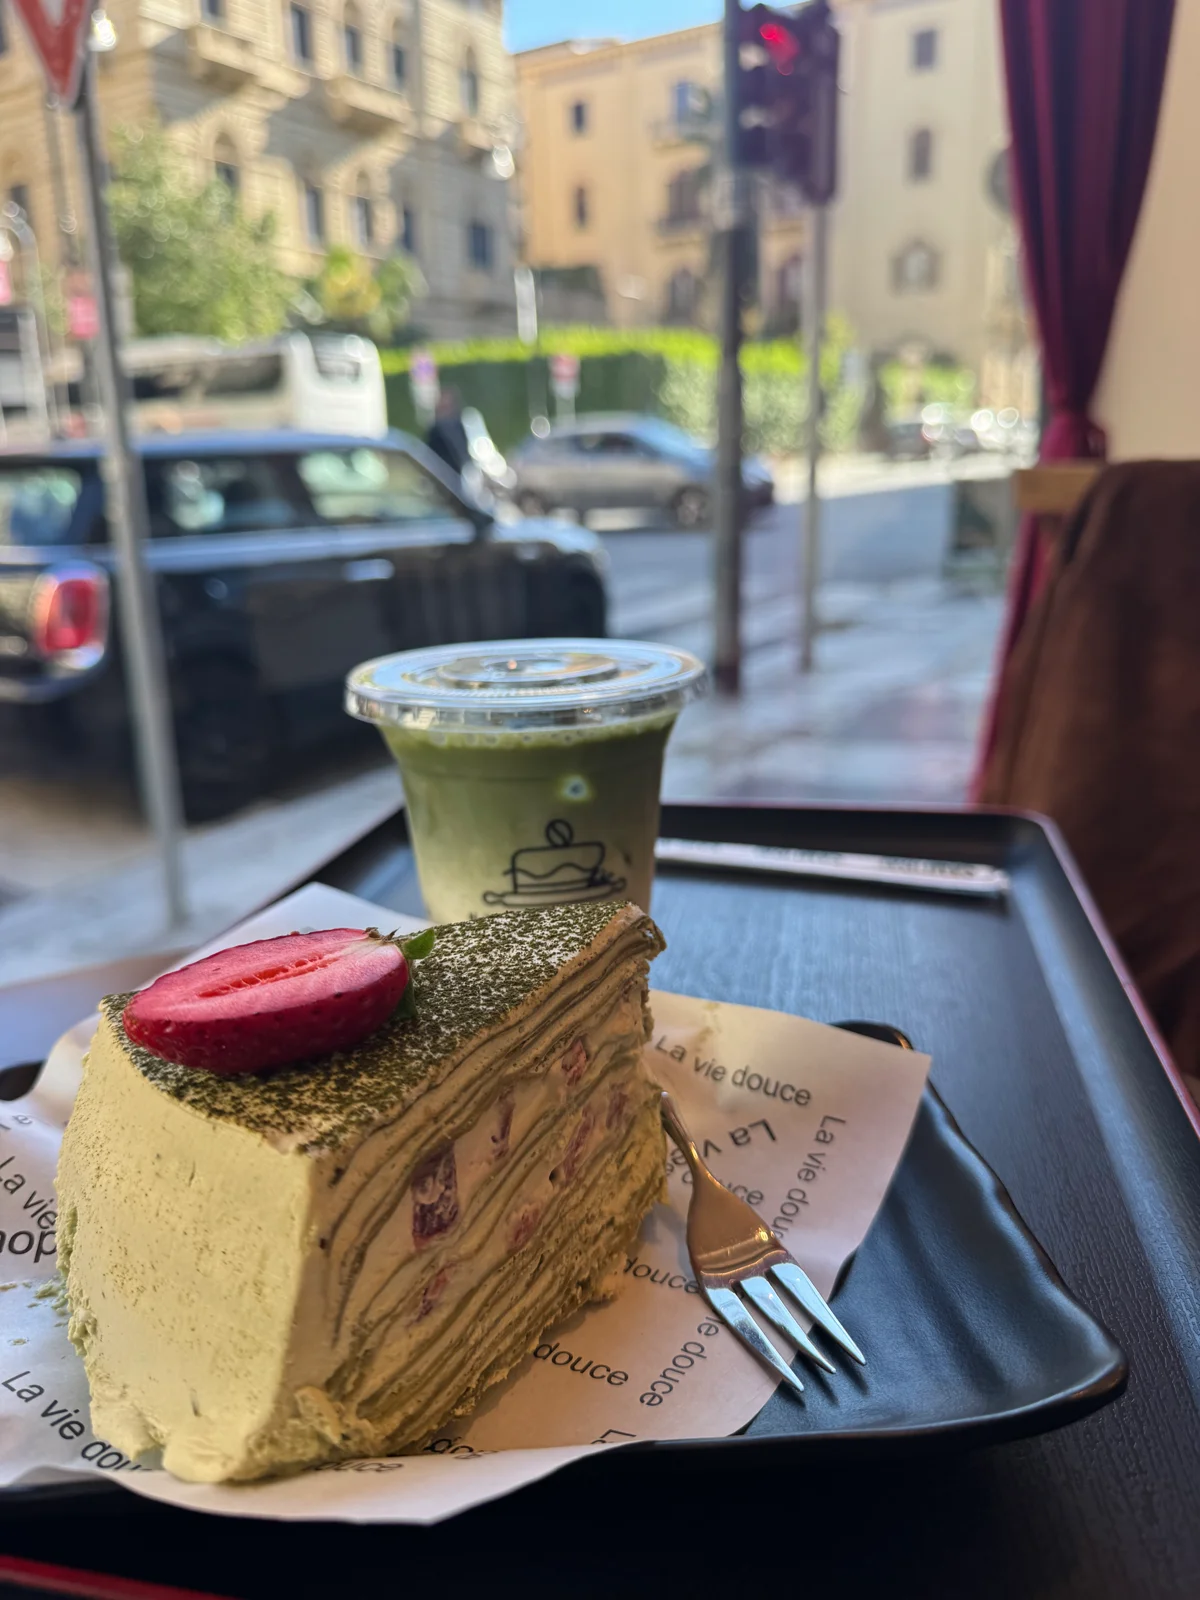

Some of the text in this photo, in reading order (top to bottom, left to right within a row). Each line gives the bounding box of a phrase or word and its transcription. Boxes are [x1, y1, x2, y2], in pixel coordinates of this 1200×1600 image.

[655, 1035, 811, 1106] La vie douce
[728, 1118, 777, 1147] La
[23, 1190, 58, 1229] vie
[771, 1115, 846, 1239] La vie dou
[533, 1342, 629, 1386] douce
[639, 1341, 707, 1407] douce
[1, 1370, 45, 1403] La
[41, 1399, 85, 1440] vie
